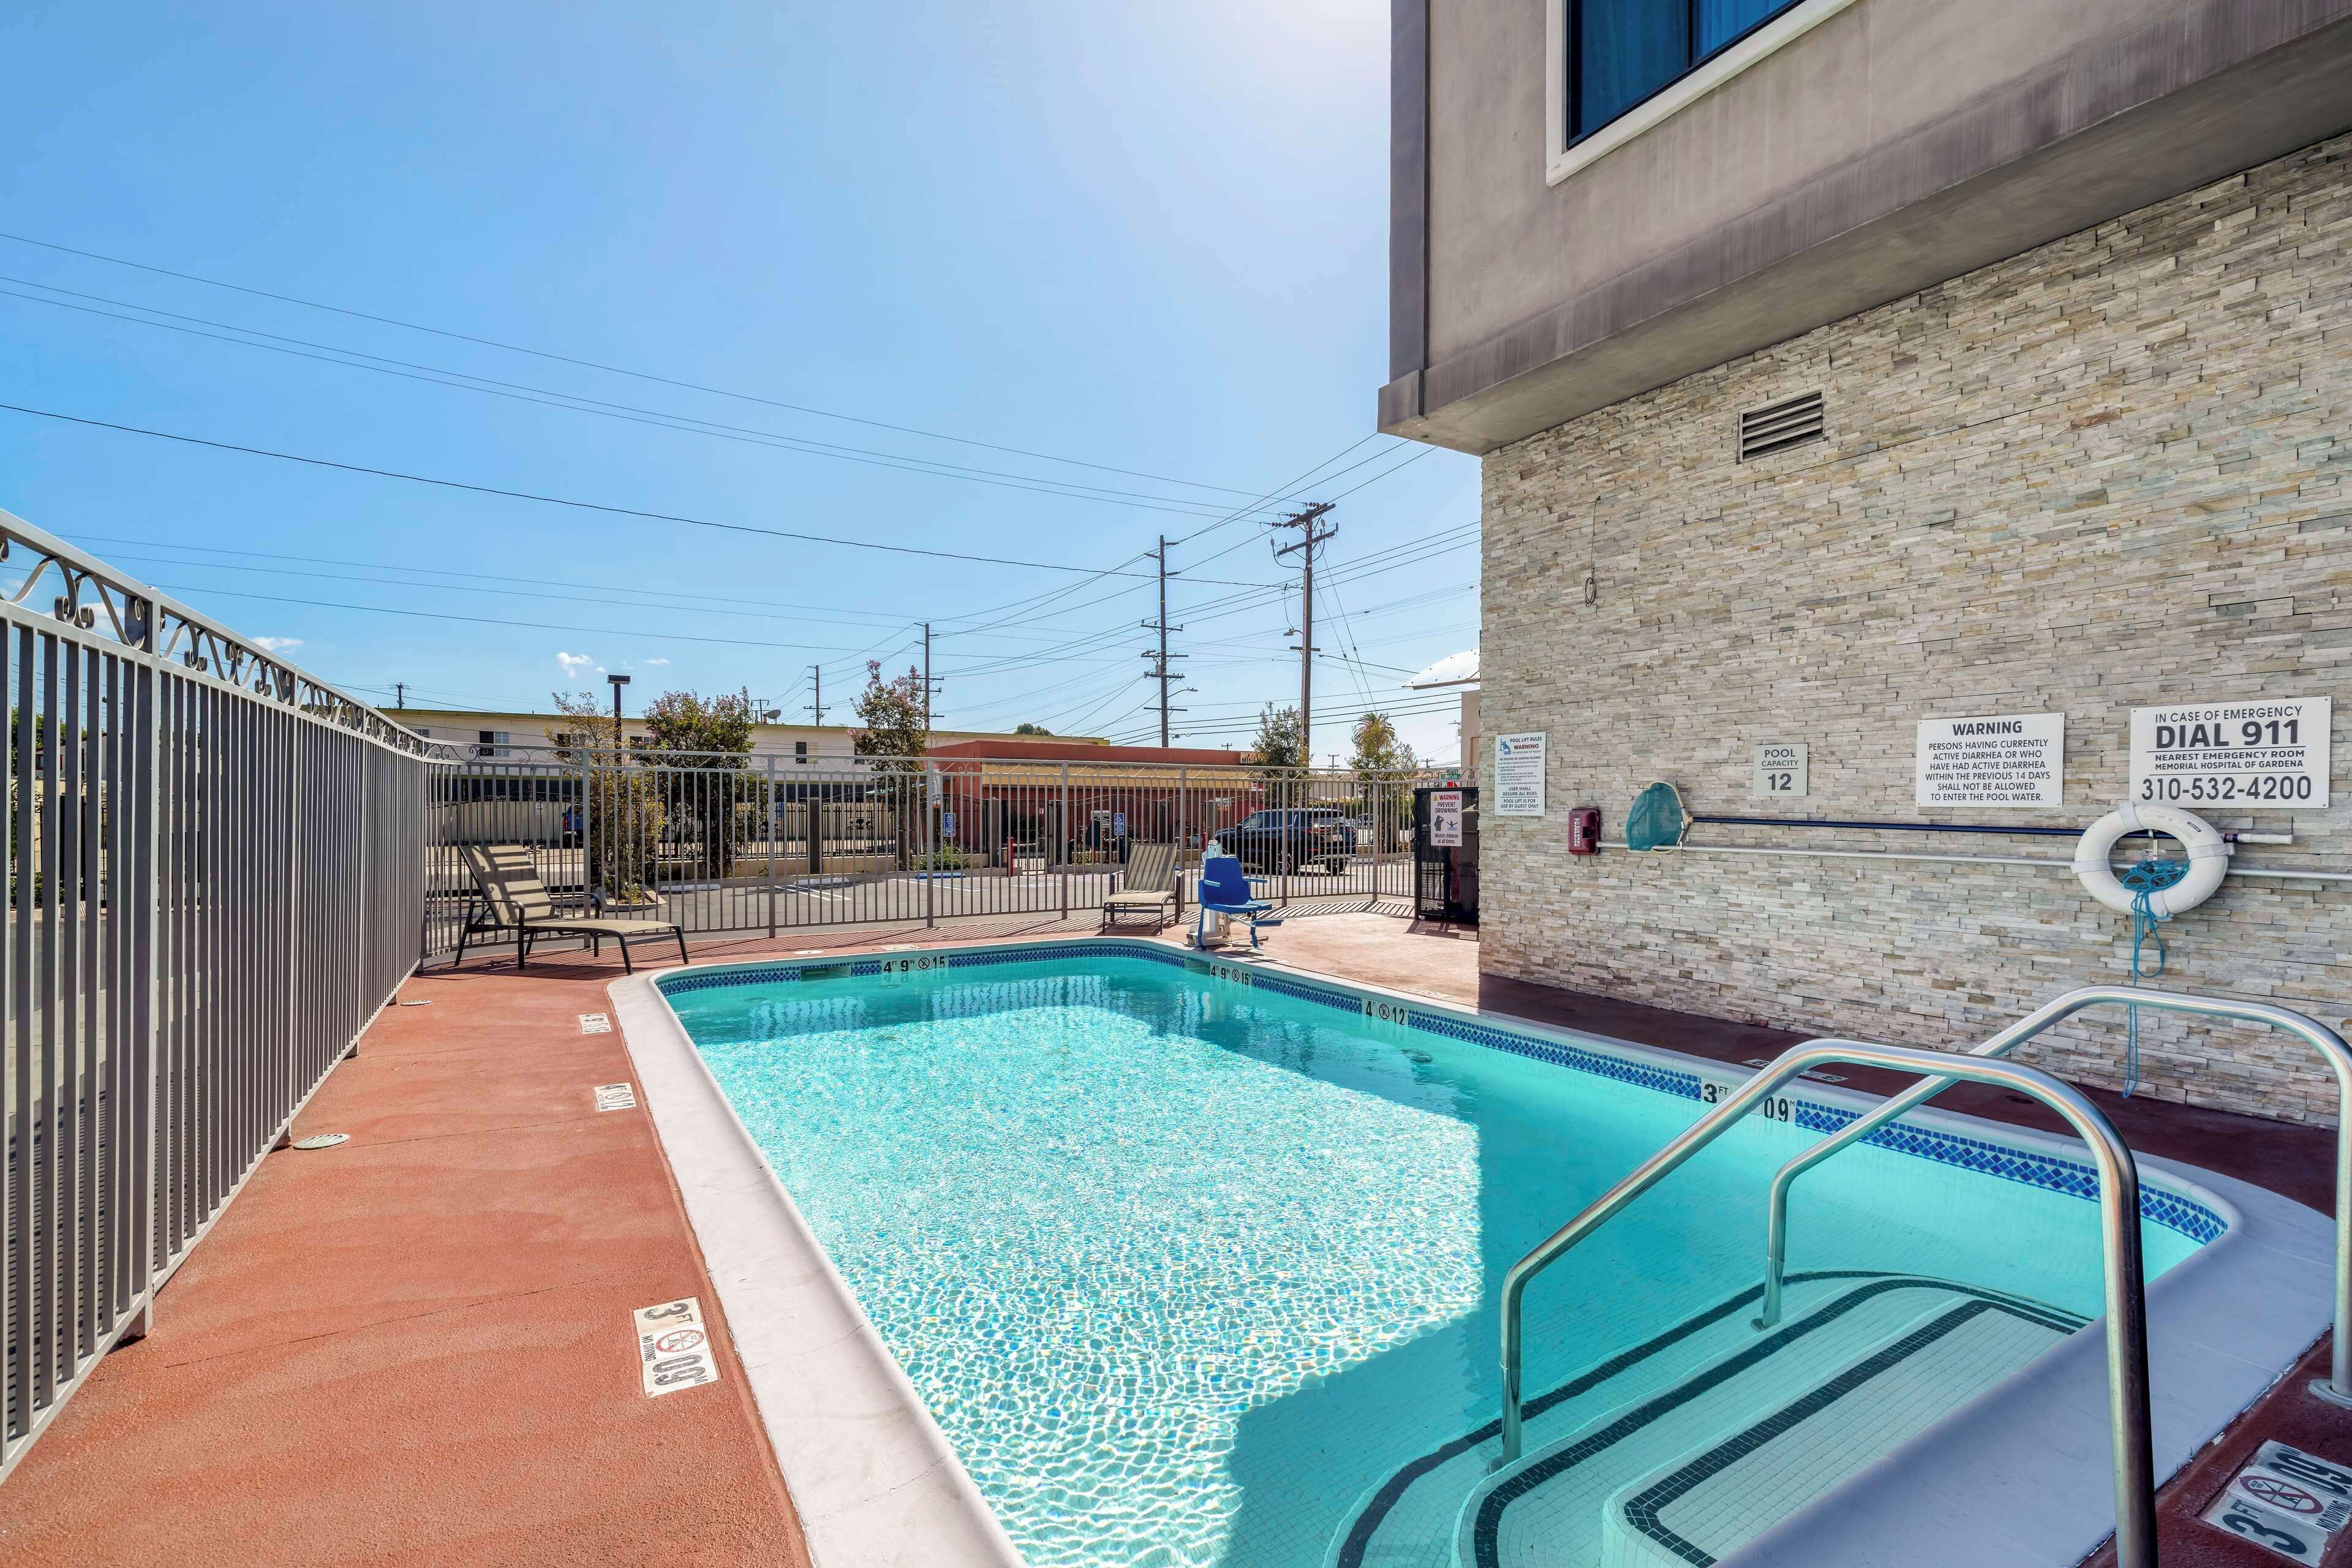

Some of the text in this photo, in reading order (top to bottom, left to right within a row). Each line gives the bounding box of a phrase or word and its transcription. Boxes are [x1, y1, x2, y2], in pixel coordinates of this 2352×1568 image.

[2155, 706, 2302, 723] IN CASE OF EMERGENCY
[1953, 721, 2022, 736] WARNING
[2156, 720, 2298, 748] DIAL 911
[2000, 739, 2048, 748] CURRENTLY
[1765, 749, 1795, 758] POOL
[2203, 751, 2267, 760] EMERGENCY
[1768, 773, 1792, 790] 12
[2141, 775, 2312, 800] 310-532-4200
[883, 962, 892, 973] 4
[900, 960, 908, 971] 9
[1211, 966, 1216, 976] 4
[1221, 968, 1226, 979] 9
[1366, 1001, 1372, 1017] 4
[1704, 1084, 1717, 1104] 3
[1719, 1087, 1728, 1095] FT
[644, 1303, 693, 1323] 3 FT
[642, 1335, 657, 1362] NO DIVING
[695, 1375, 709, 1384] M
[2323, 1500, 2352, 1527] DIVING
[2222, 1499, 2307, 1555] 3 FT
